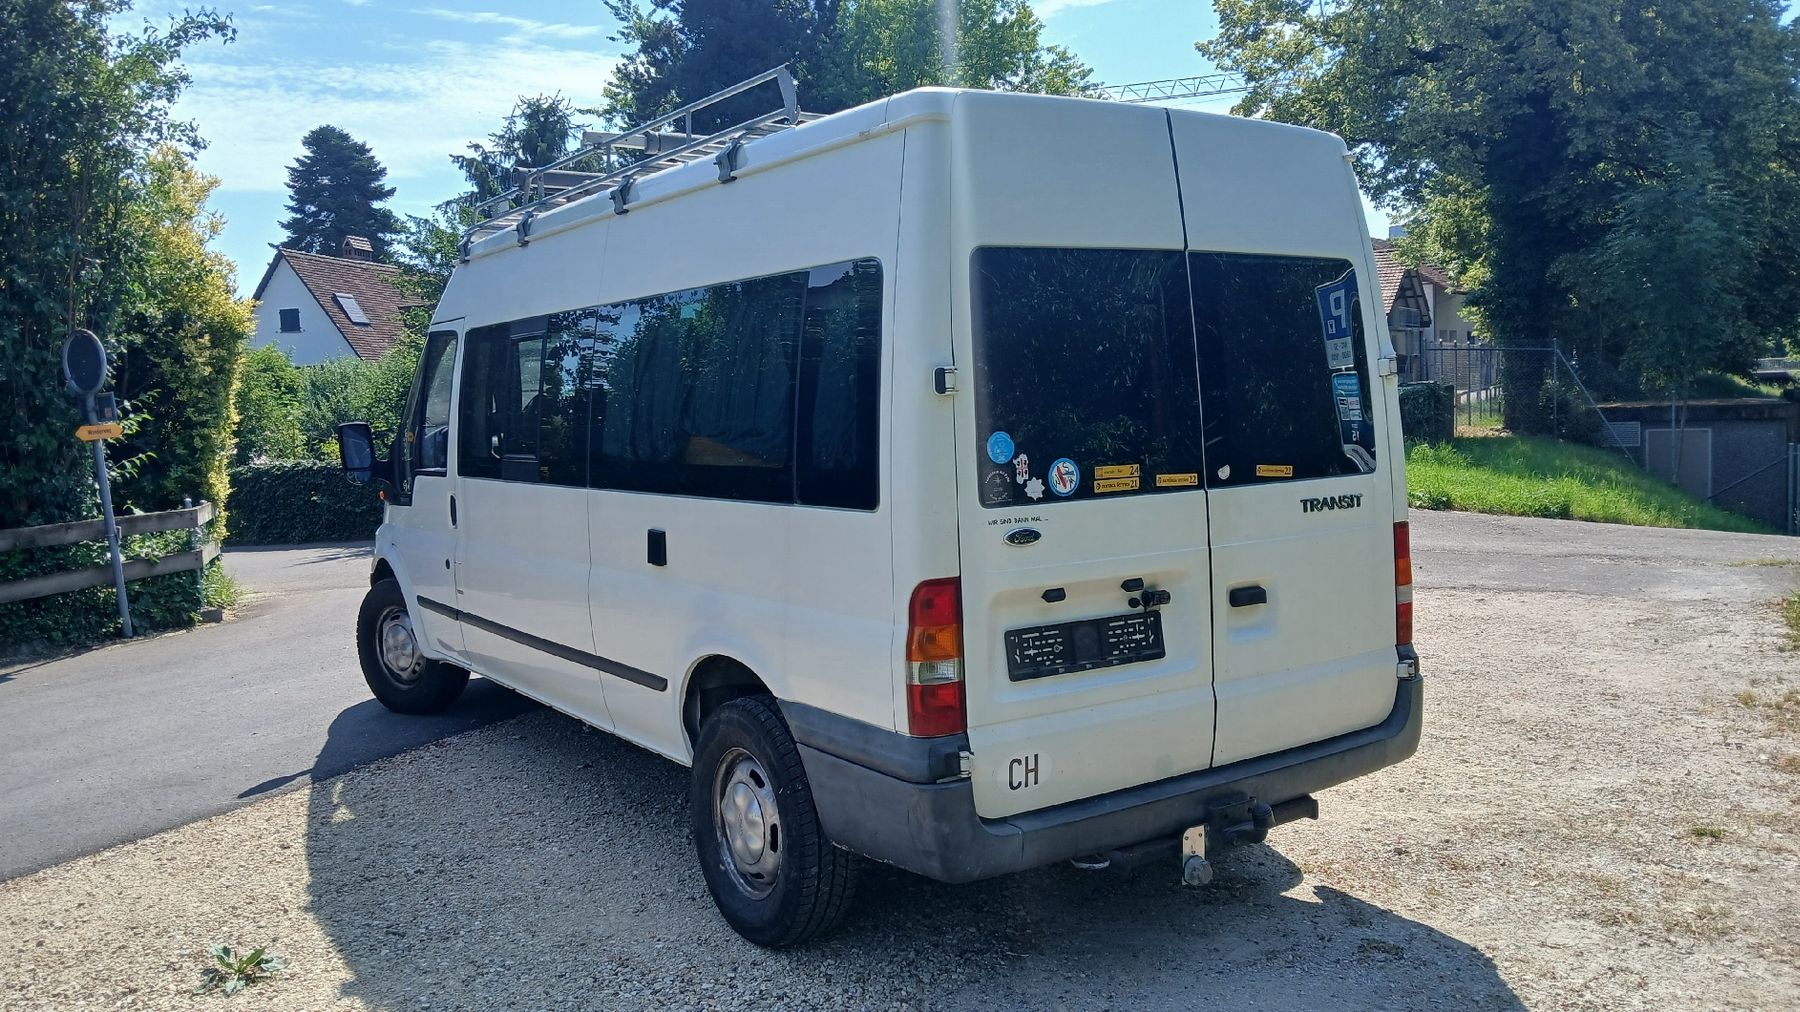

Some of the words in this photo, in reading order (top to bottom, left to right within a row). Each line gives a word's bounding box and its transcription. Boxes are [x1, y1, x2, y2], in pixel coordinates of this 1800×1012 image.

[1129, 465, 1139, 476] 24
[1284, 466, 1292, 475] 22
[1130, 480, 1138, 488] 21
[1189, 475, 1197, 484] 22
[1300, 494, 1363, 513] TRANSIT
[988, 519, 998, 527] WIR
[1000, 517, 1012, 525] SIND
[1008, 753, 1039, 791] CH
